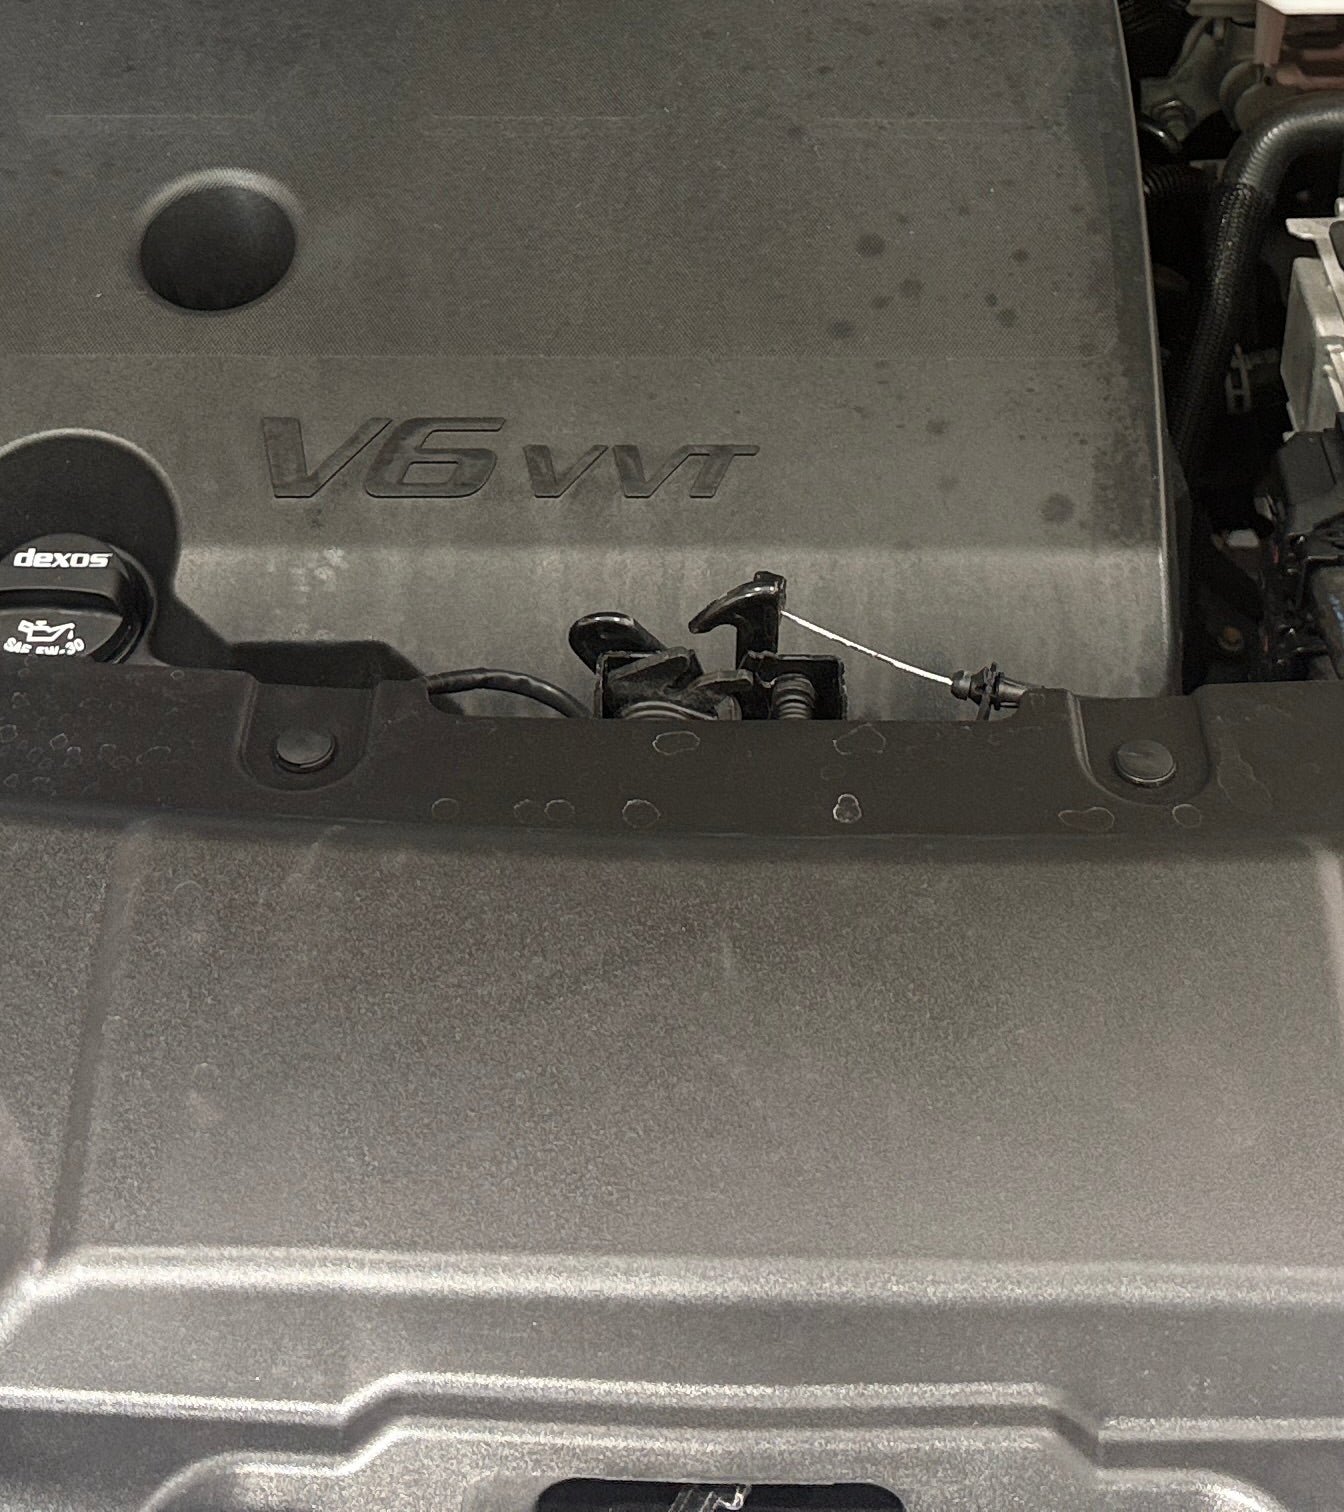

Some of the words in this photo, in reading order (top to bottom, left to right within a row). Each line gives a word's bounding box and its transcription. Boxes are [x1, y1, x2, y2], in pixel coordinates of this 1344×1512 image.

[261, 416, 507, 499] V6
[522, 443, 761, 499] VVT
[13, 548, 114, 568] dexos
